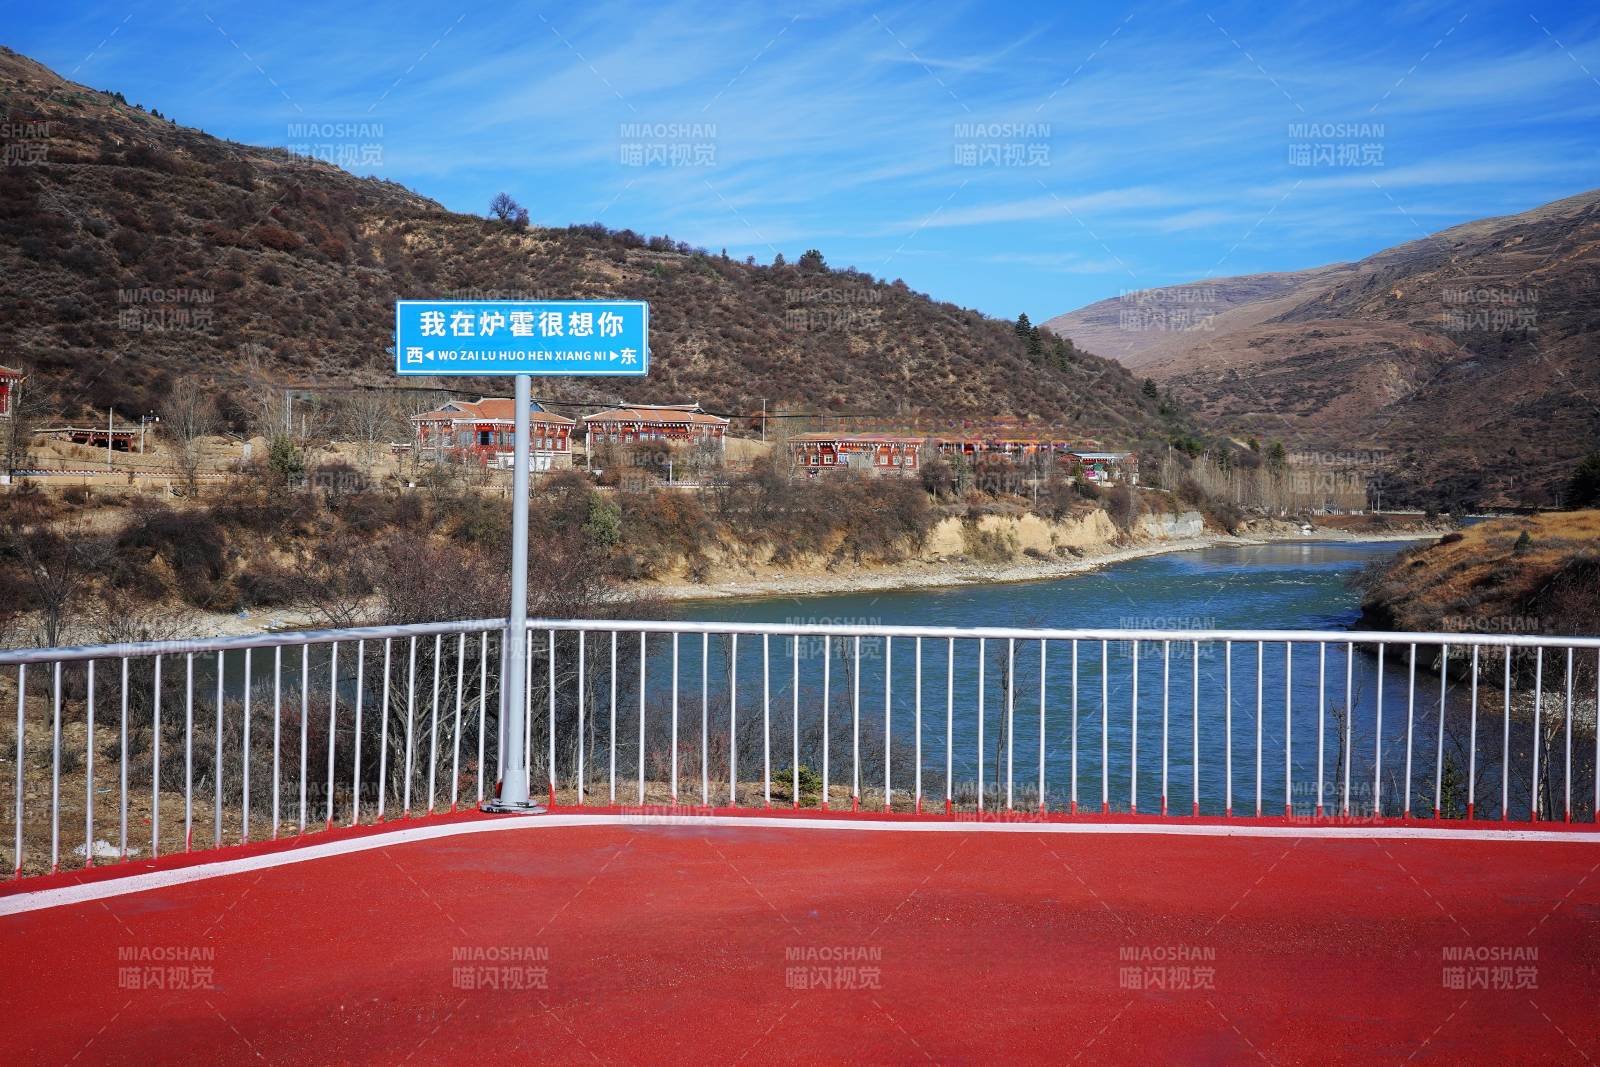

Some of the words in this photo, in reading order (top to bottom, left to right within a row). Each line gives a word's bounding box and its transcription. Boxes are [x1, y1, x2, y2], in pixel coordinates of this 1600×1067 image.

[420, 311, 624, 337] 我在炉霍很想你
[406, 347, 423, 364] 西
[438, 350, 458, 361] WO
[460, 350, 479, 361] ZAI
[481, 350, 496, 361] LU
[500, 350, 525, 361] HUO
[528, 350, 552, 361] HEN
[555, 350, 591, 361] XIANG
[594, 350, 606, 361] NI
[620, 348, 637, 365] 东
